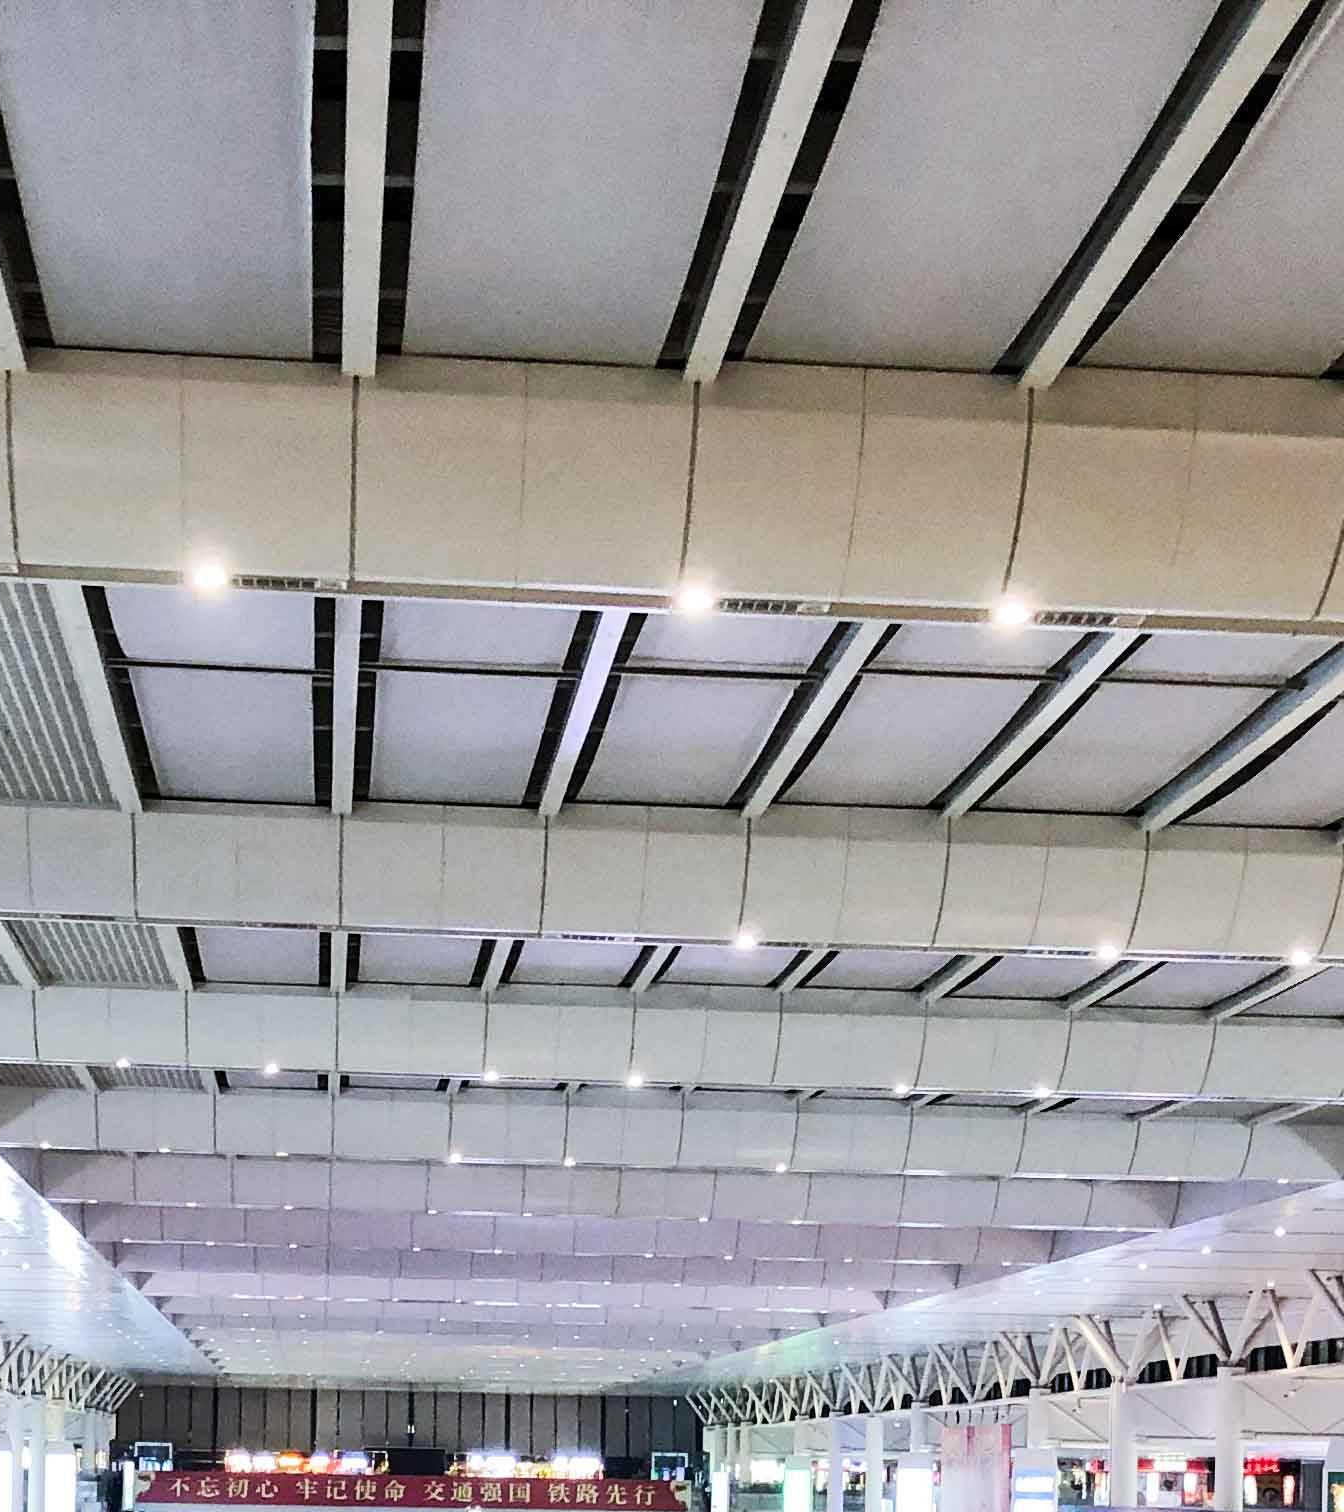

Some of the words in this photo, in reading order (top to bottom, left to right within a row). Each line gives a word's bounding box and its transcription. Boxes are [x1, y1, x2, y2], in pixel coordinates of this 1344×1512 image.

[169, 1478, 279, 1499] 不忘初心
[295, 1480, 407, 1502] 牢记使命
[423, 1481, 530, 1504] 交通强国
[547, 1484, 656, 1506] 铁路先行
